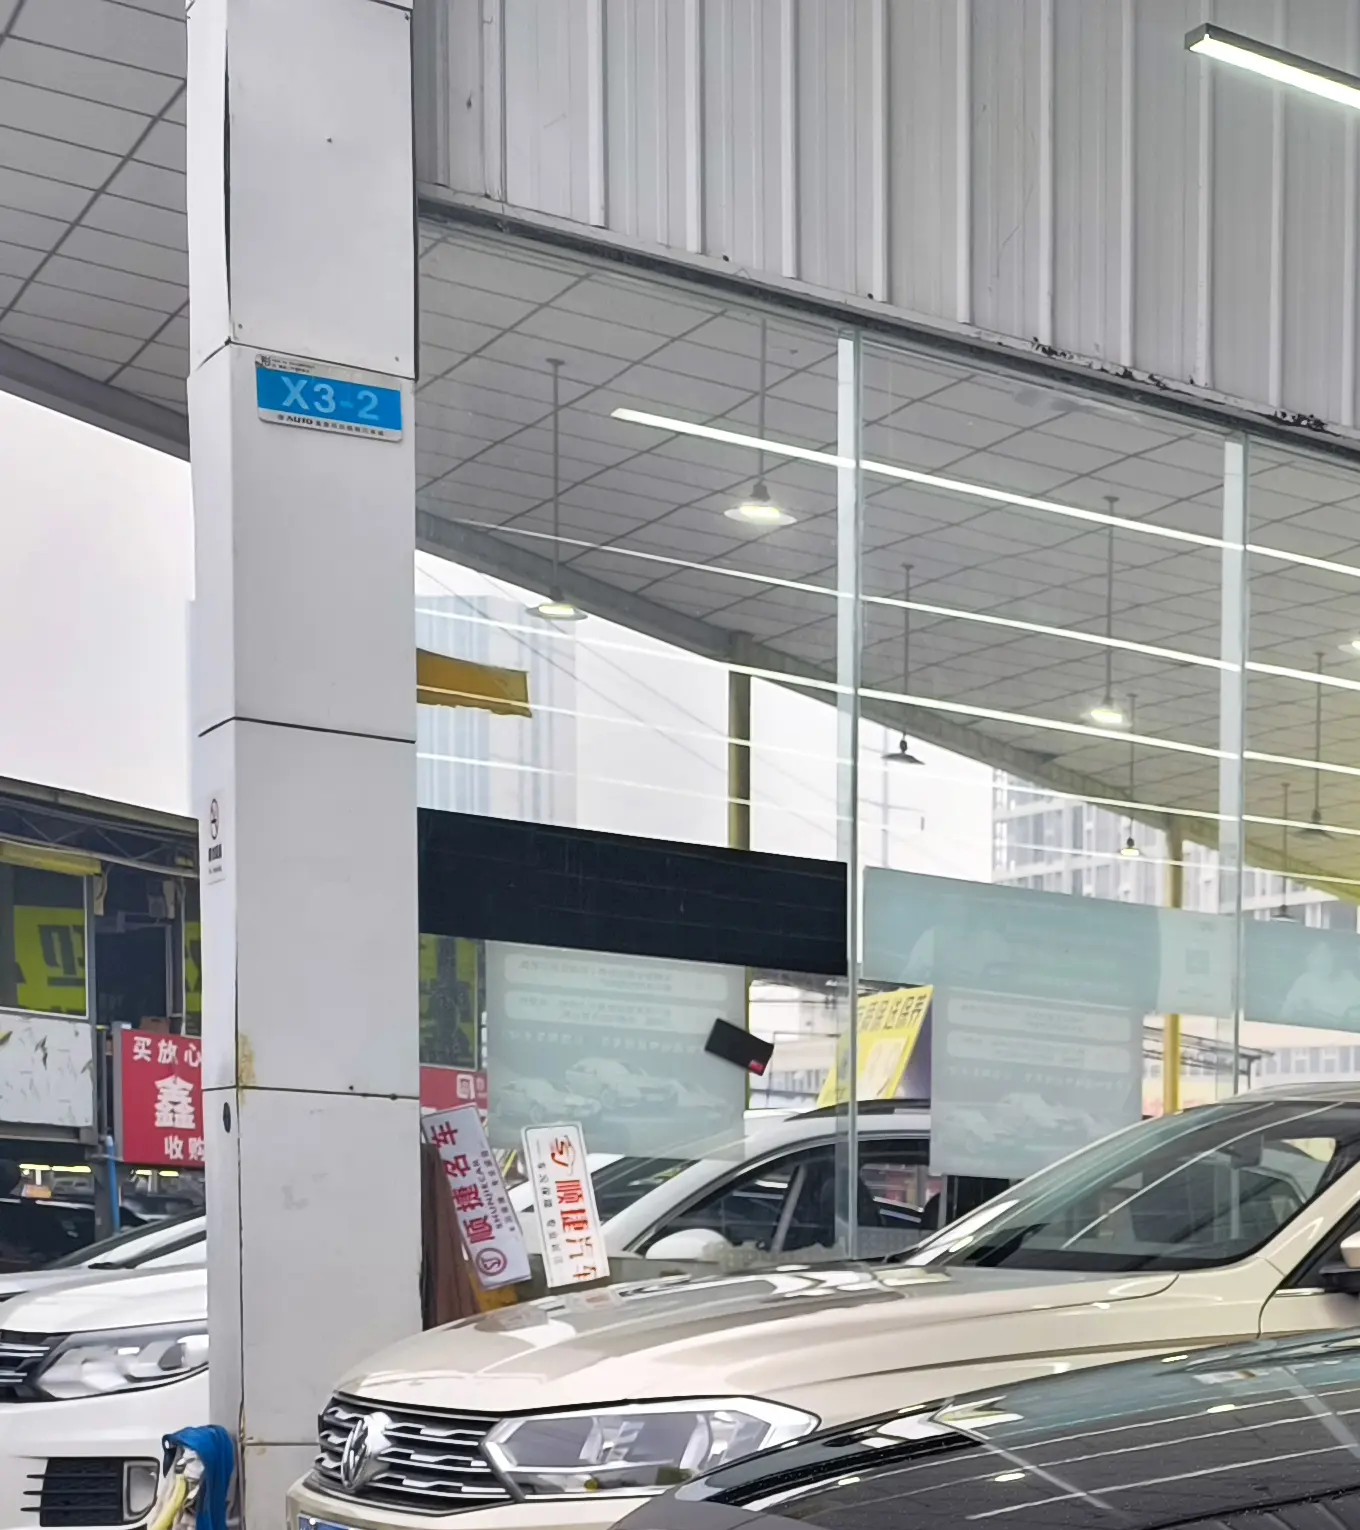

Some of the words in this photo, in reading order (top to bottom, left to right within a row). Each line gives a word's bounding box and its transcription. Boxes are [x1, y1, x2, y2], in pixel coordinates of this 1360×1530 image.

[281, 375, 380, 421] X3-2
[132, 1035, 202, 1068] 买放心
[154, 1075, 196, 1130] 鑫
[164, 1135, 205, 1162] 收购
[430, 1121, 496, 1244] 顺捷名车
